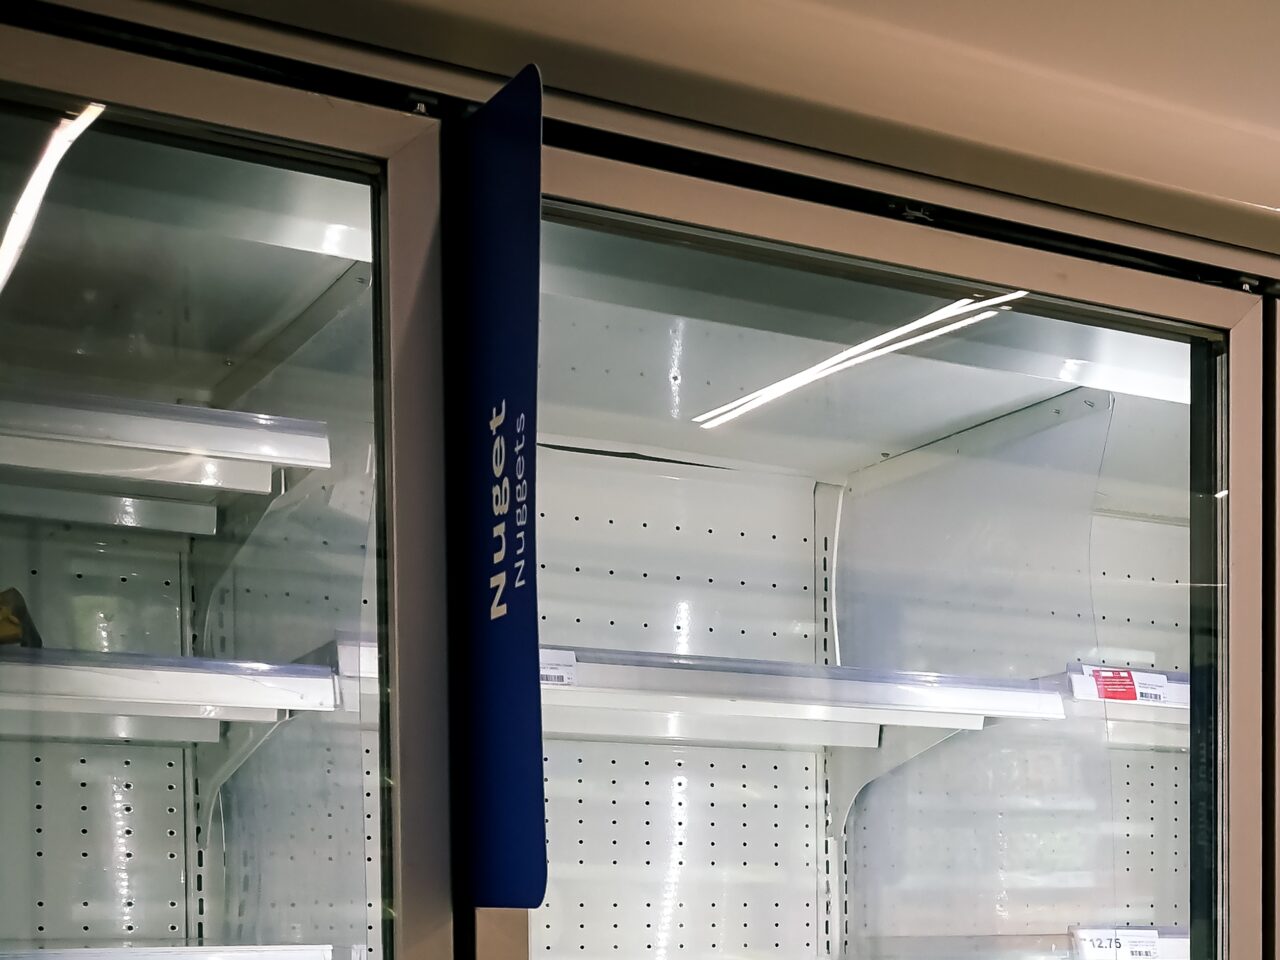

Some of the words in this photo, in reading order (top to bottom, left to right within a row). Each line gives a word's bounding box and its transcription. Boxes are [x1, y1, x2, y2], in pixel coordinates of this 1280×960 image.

[489, 399, 510, 620] Nuget
[514, 412, 528, 588] Nuggets
[1089, 938, 1122, 949] 12.75
